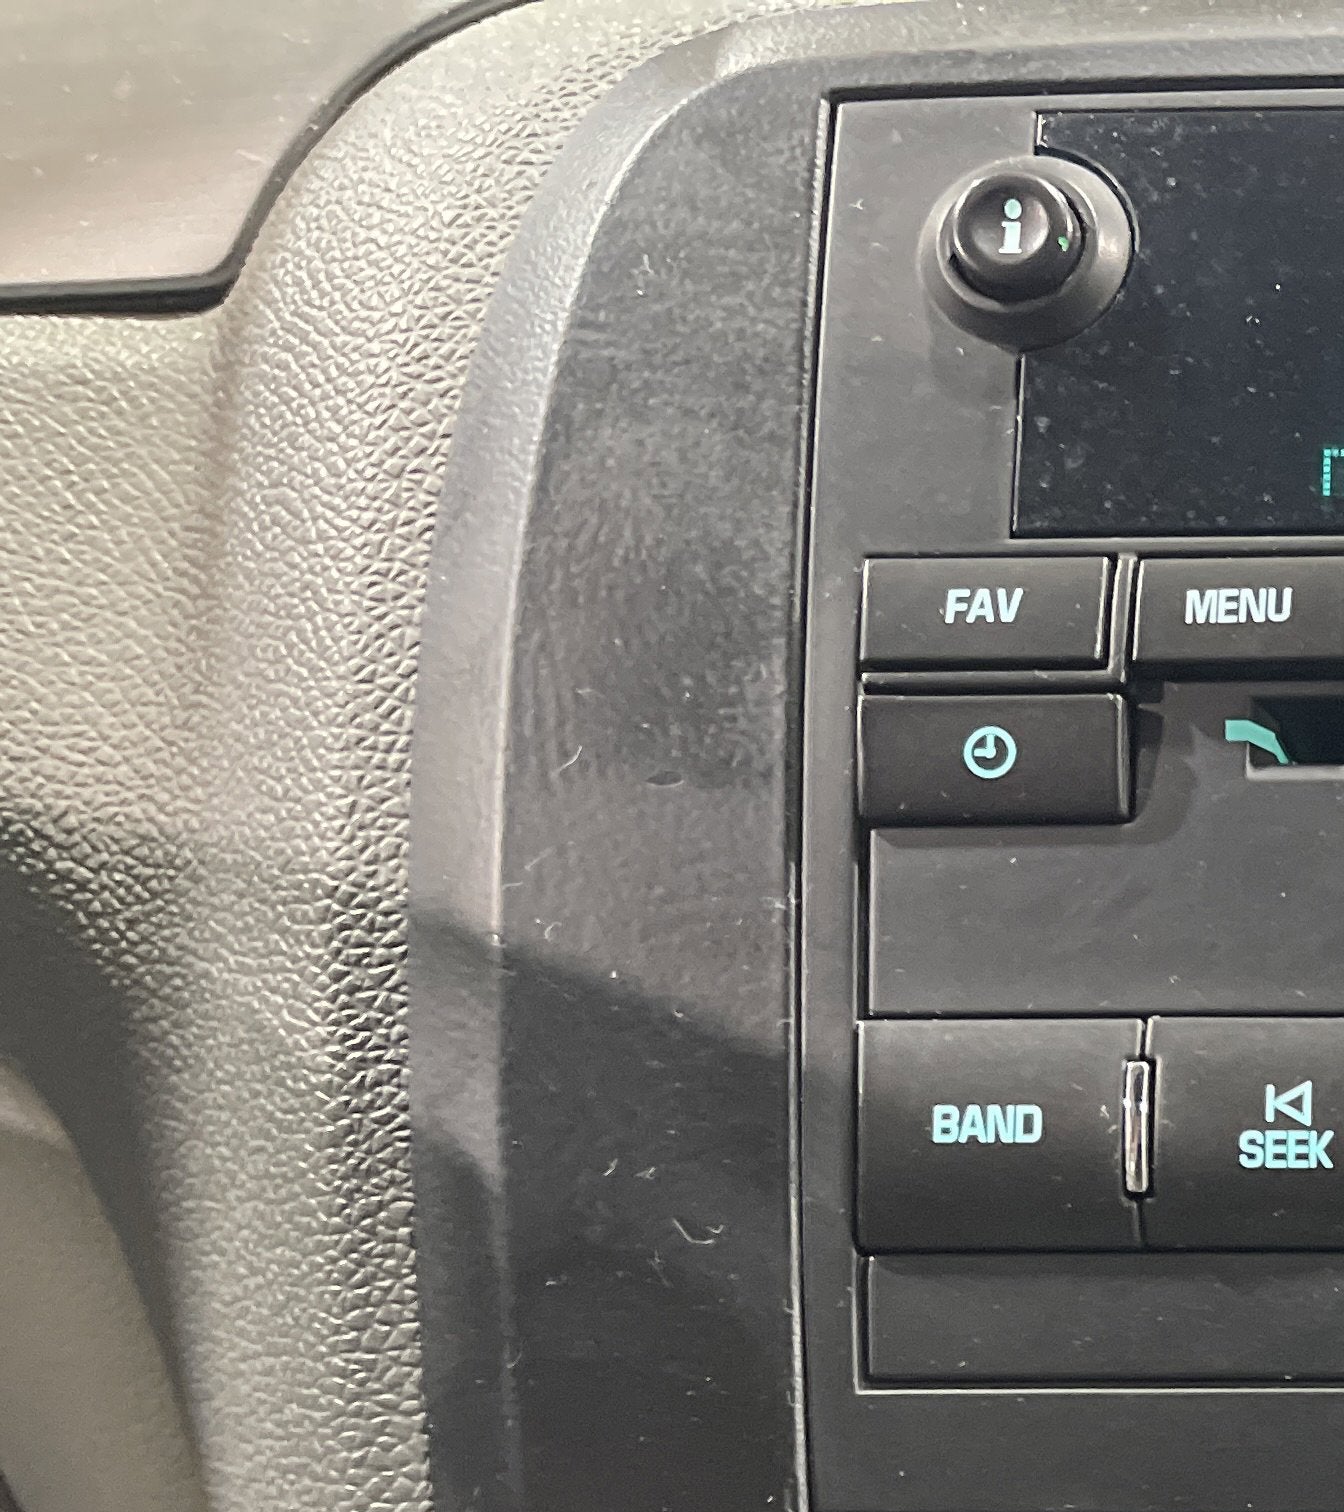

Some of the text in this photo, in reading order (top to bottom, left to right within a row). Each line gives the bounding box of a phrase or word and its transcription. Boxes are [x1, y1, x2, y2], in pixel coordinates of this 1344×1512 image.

[944, 587, 1024, 624] FAV
[1184, 586, 1293, 625] MENU
[932, 1103, 1043, 1144] BAND
[1238, 1129, 1335, 1169] SEEK
